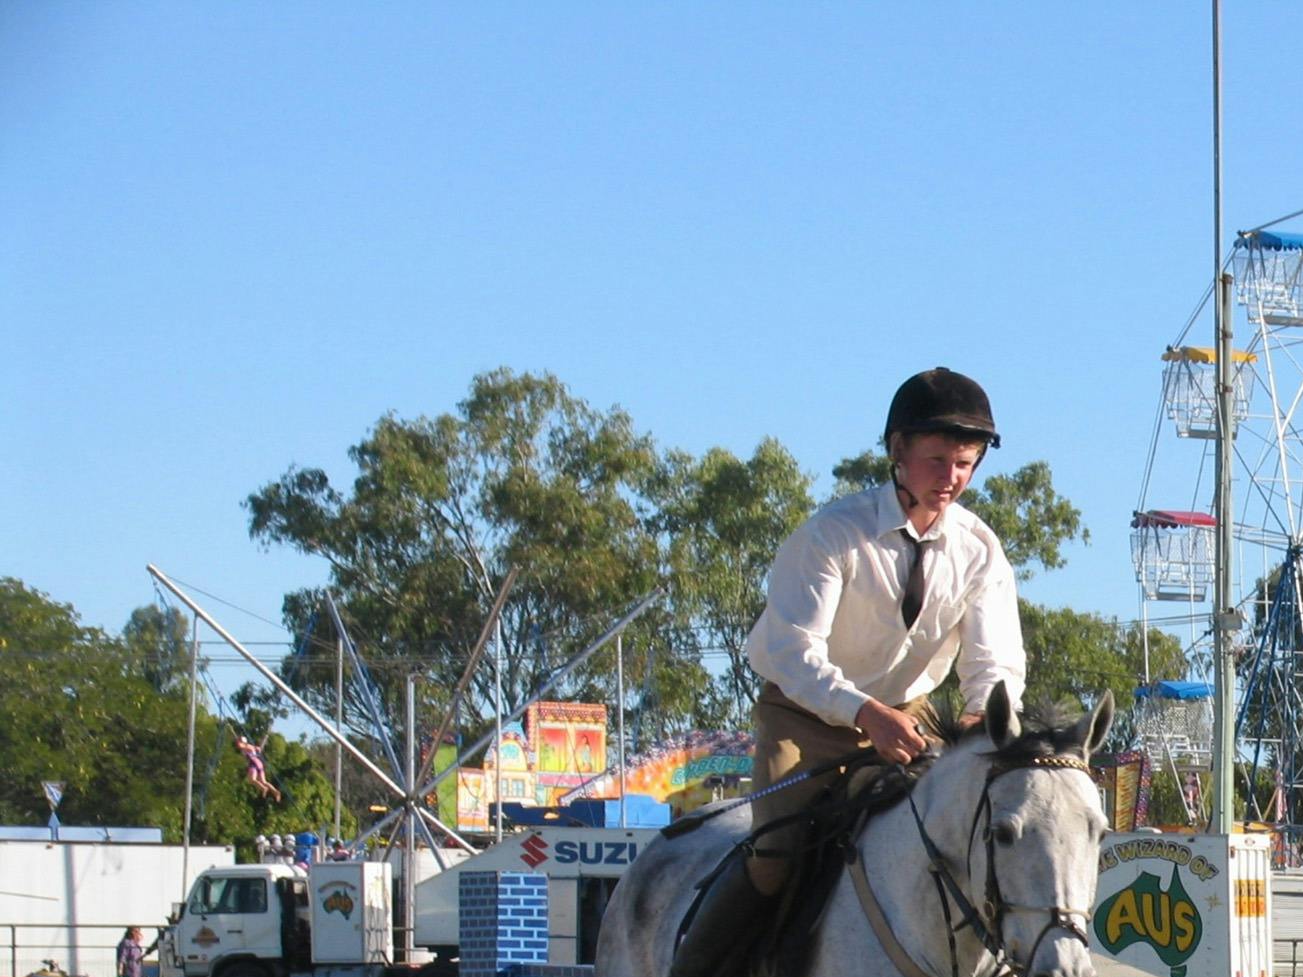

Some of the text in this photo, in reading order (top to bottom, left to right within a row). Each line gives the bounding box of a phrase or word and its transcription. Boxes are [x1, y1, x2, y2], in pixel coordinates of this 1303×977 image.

[1114, 838, 1193, 866] WIZARD
[1189, 855, 1220, 882] OF
[1106, 889, 1195, 952] AUS
